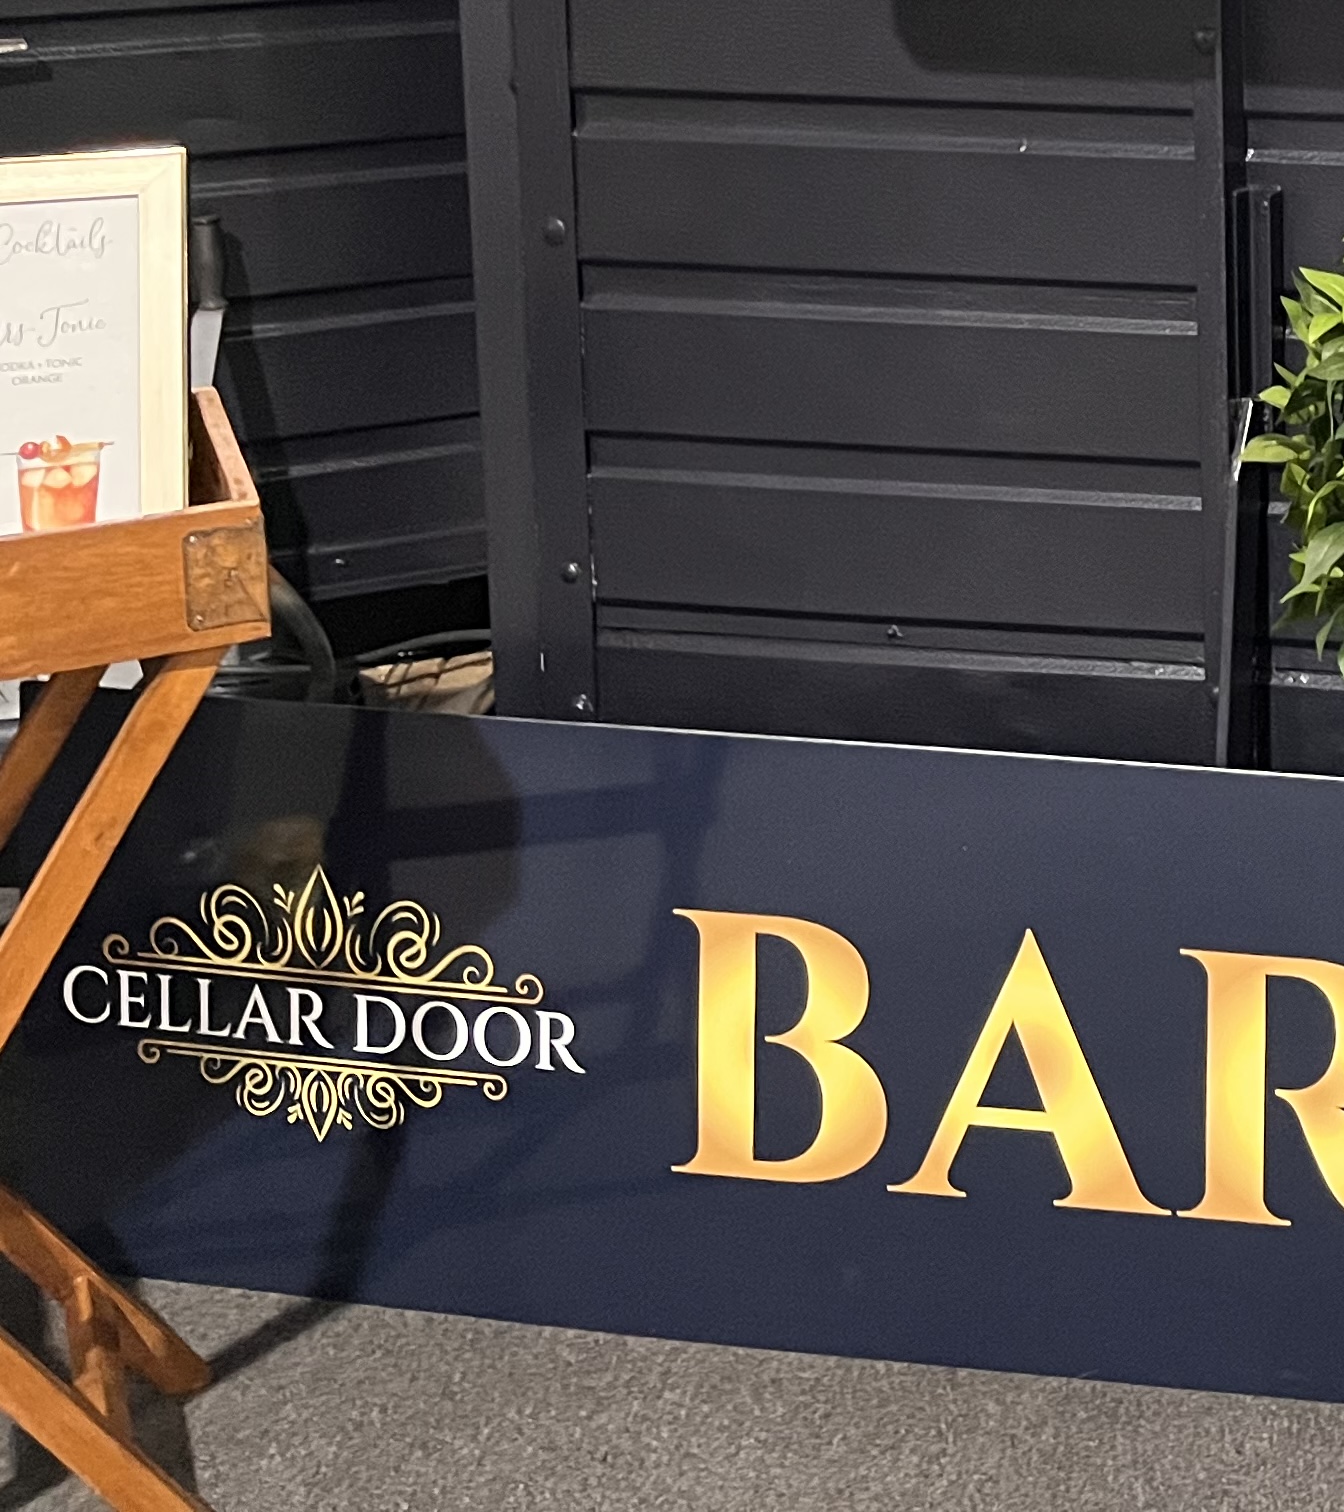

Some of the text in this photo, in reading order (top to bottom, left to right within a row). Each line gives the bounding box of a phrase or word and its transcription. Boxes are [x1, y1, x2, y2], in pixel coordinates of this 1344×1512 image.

[0, 361, 34, 372] ODKA
[63, 964, 586, 1075] CELLAR DOOR
